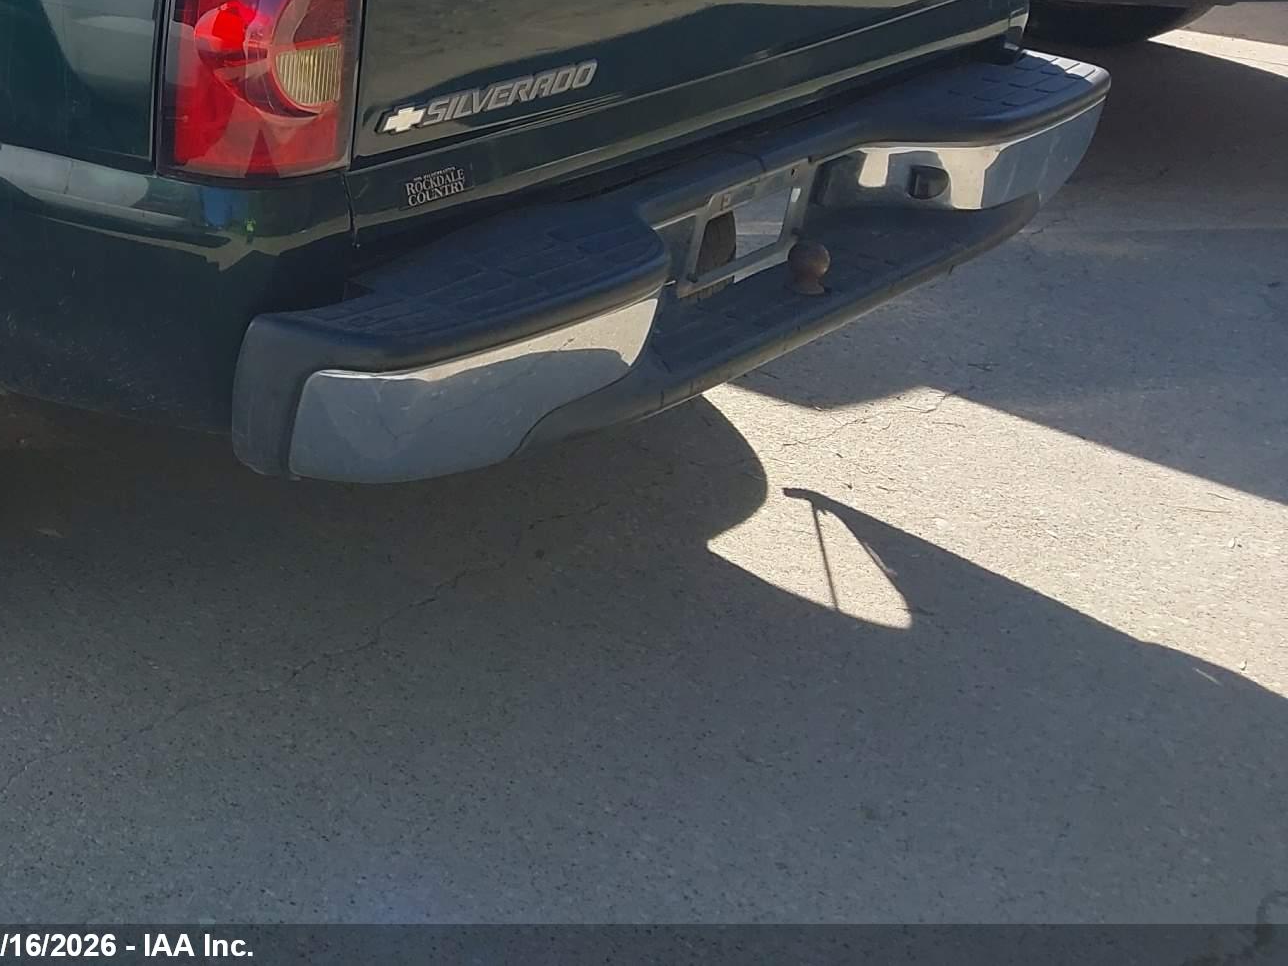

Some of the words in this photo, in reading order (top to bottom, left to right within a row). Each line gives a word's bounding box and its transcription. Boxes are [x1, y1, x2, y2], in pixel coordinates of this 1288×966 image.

[420, 59, 598, 126] SILVERADO
[406, 168, 465, 196] ROCKDALE
[408, 179, 465, 207] COUNTRY
